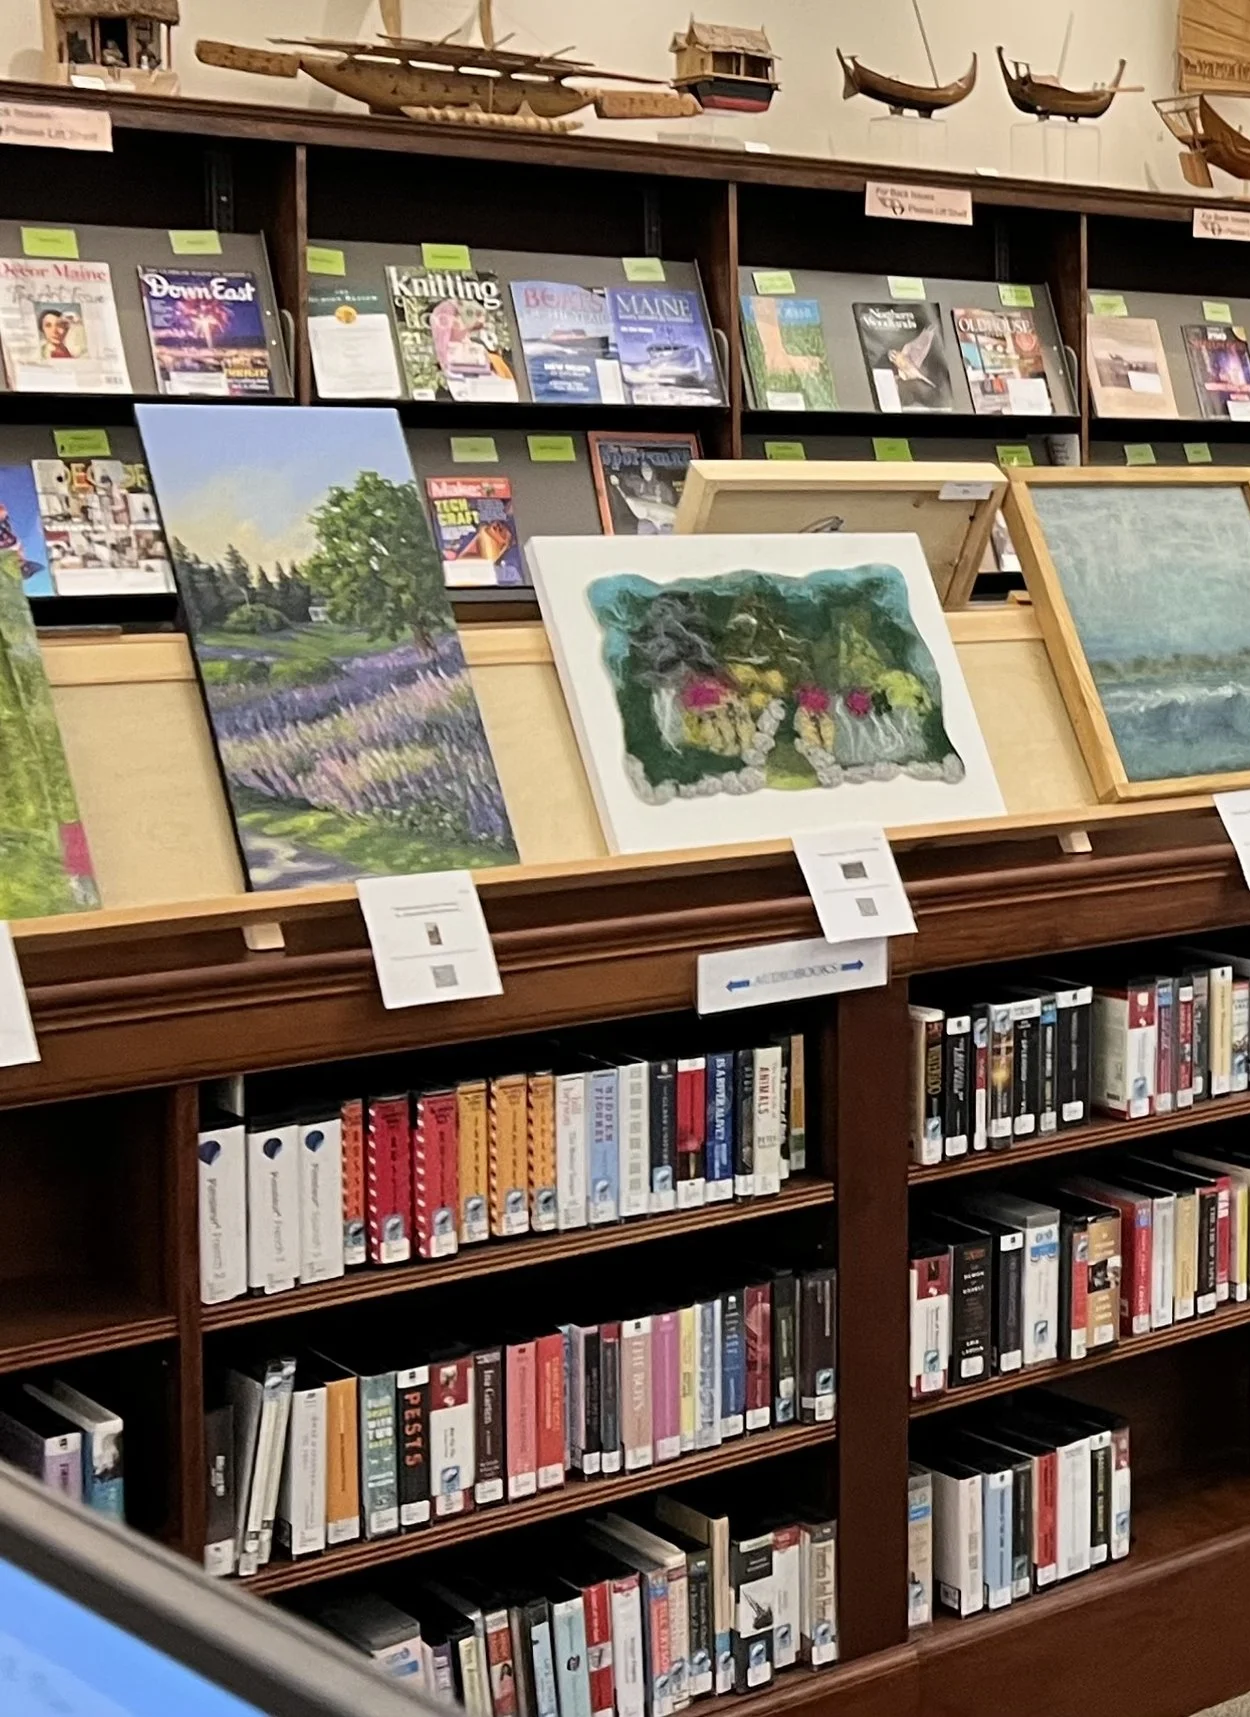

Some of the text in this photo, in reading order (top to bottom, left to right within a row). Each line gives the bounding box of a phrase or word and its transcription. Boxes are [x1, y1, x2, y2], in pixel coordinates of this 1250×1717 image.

[52, 263, 107, 283] Maine
[143, 273, 212, 300] Down
[210, 277, 256, 302] East
[388, 266, 500, 310] Knitting
[616, 293, 691, 319] MAINE
[401, 332, 421, 346] 21
[434, 498, 469, 512] TECH
[437, 510, 480, 526] CRAFT
[752, 962, 838, 986] AUDIOBOOKS
[758, 1066, 770, 1115] ANIMALS
[595, 1086, 604, 1143] FIGURES
[604, 1085, 613, 1142] HIDDEN
[632, 1341, 645, 1412] THE BOYS
[483, 1369, 495, 1424] Ina Garten
[403, 1390, 423, 1467] PESTS
